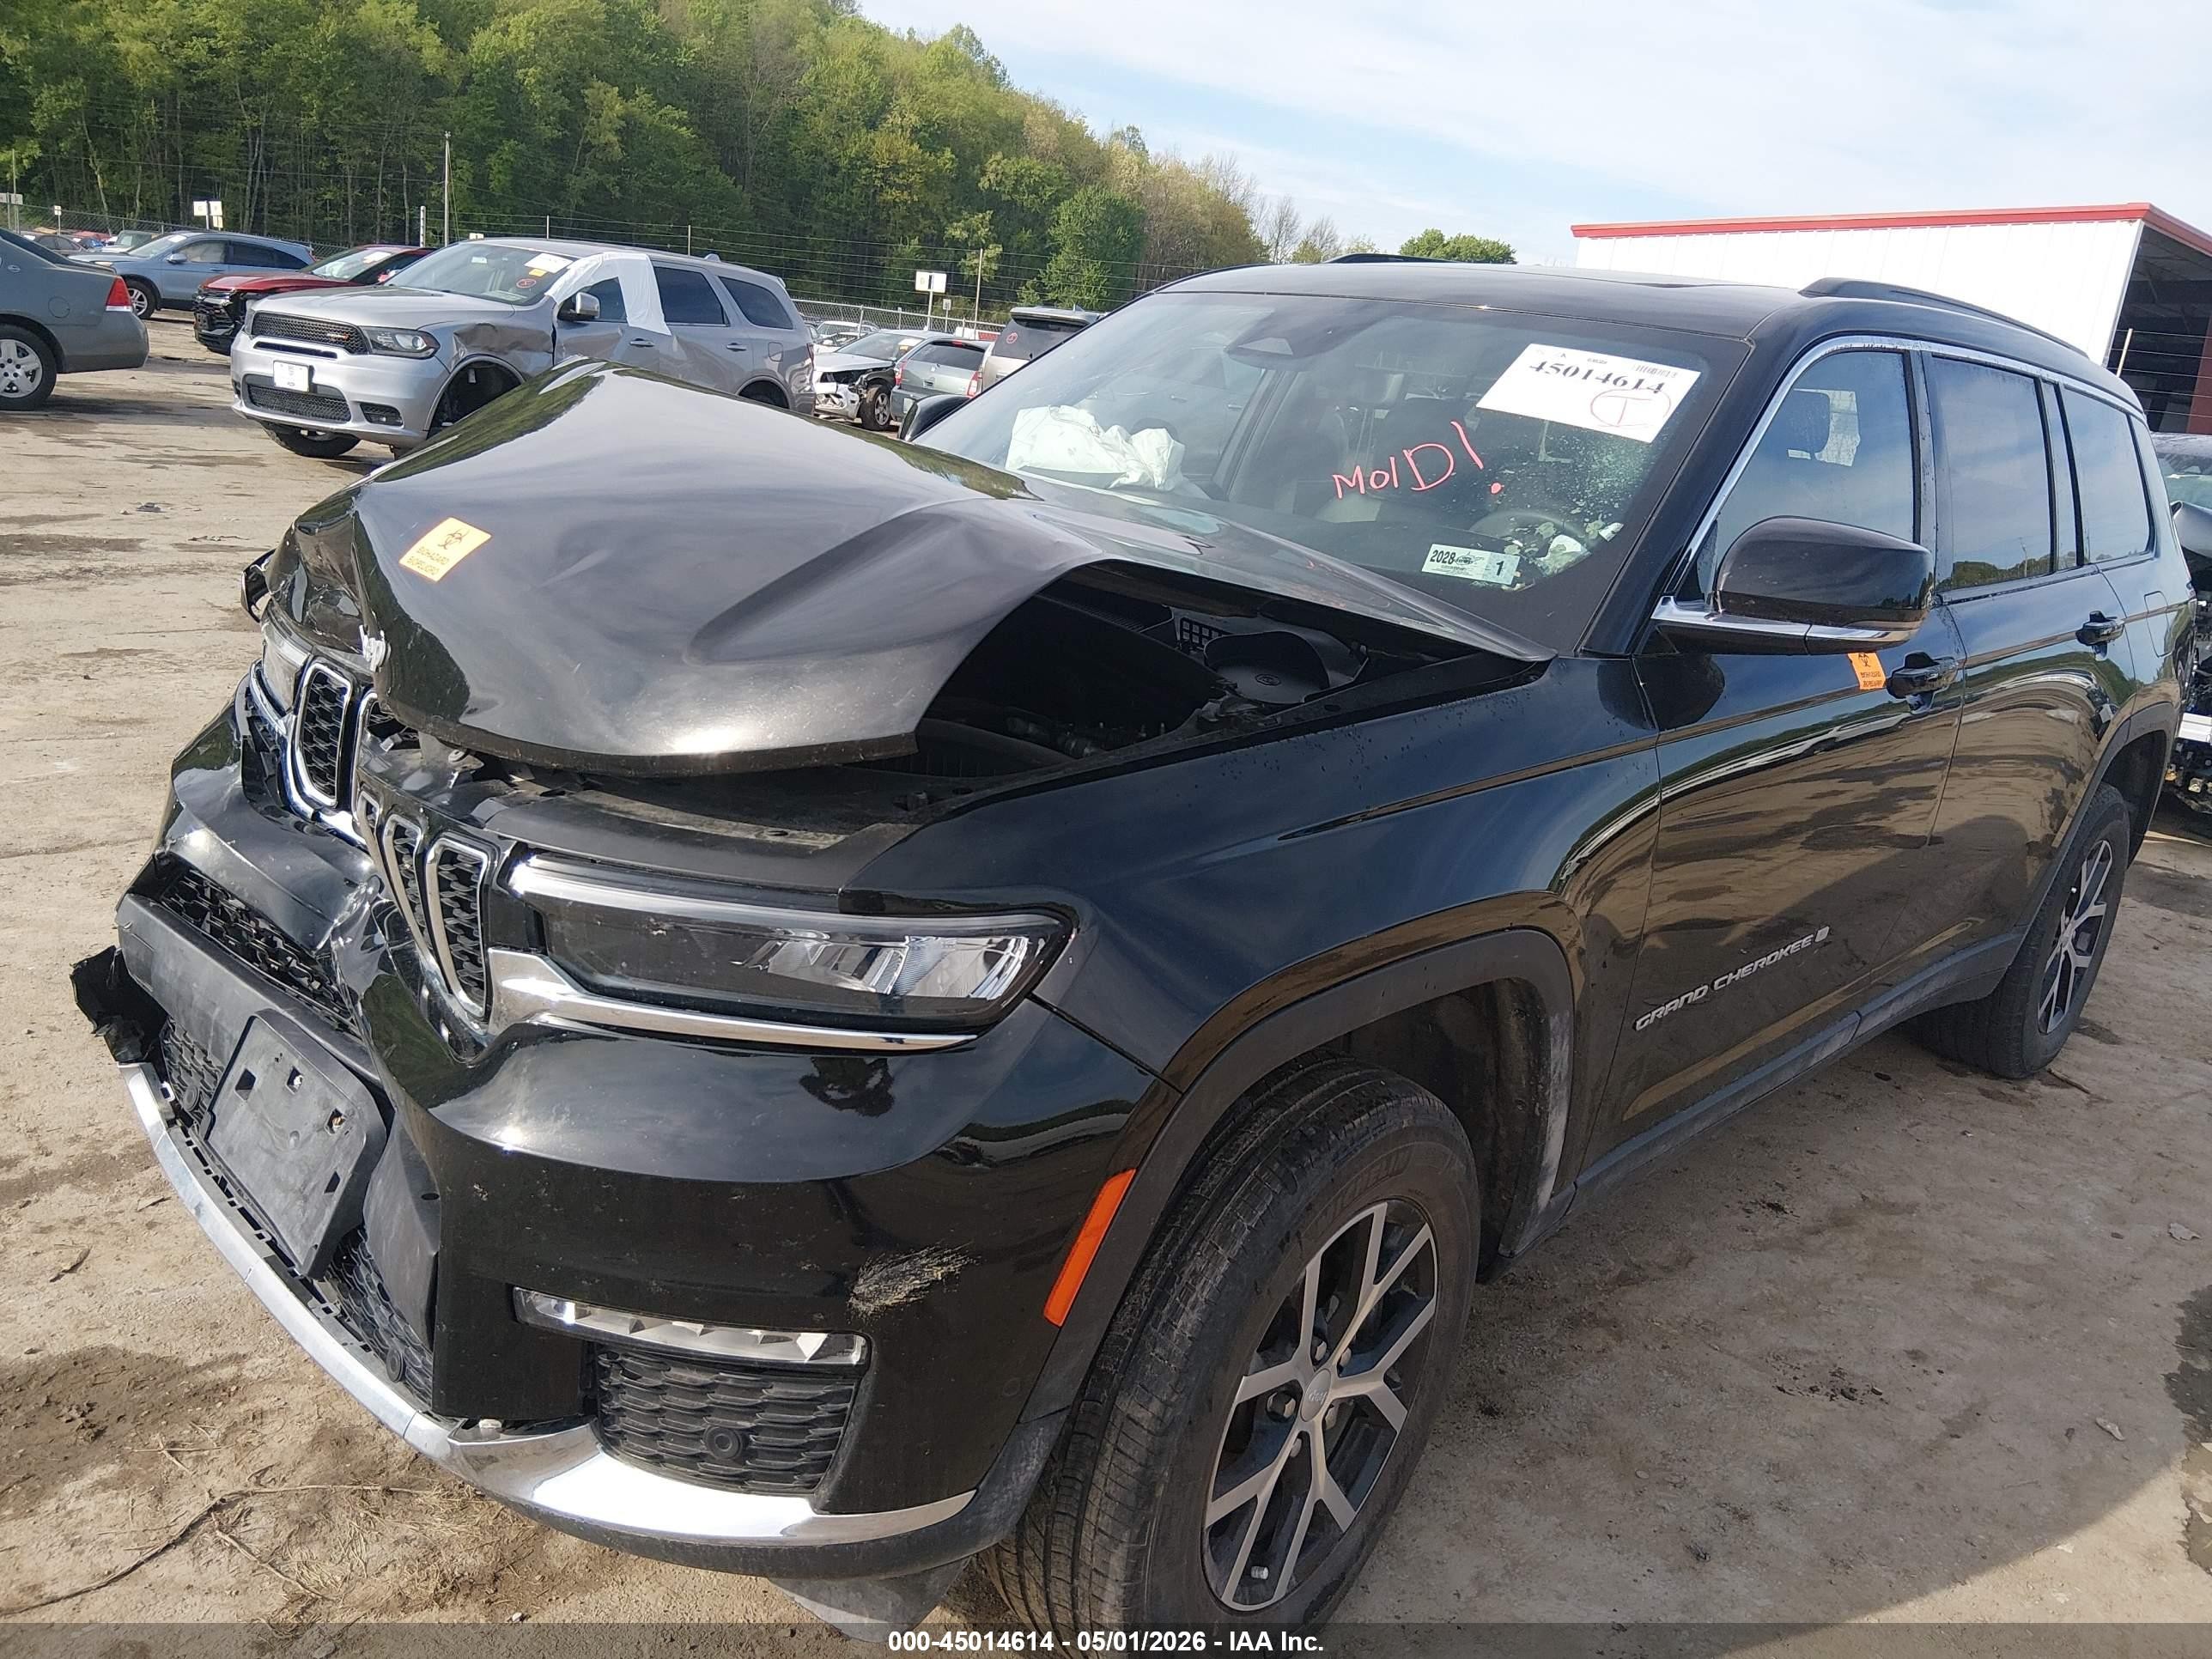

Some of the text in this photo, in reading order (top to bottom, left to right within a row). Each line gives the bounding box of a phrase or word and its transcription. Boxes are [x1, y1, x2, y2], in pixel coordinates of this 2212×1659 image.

[1528, 359, 1666, 394] 45014614
[1429, 550, 1456, 565] 2028
[1496, 560, 1504, 576] 1
[1634, 933, 1814, 1031] GRAND CHEROKEE
